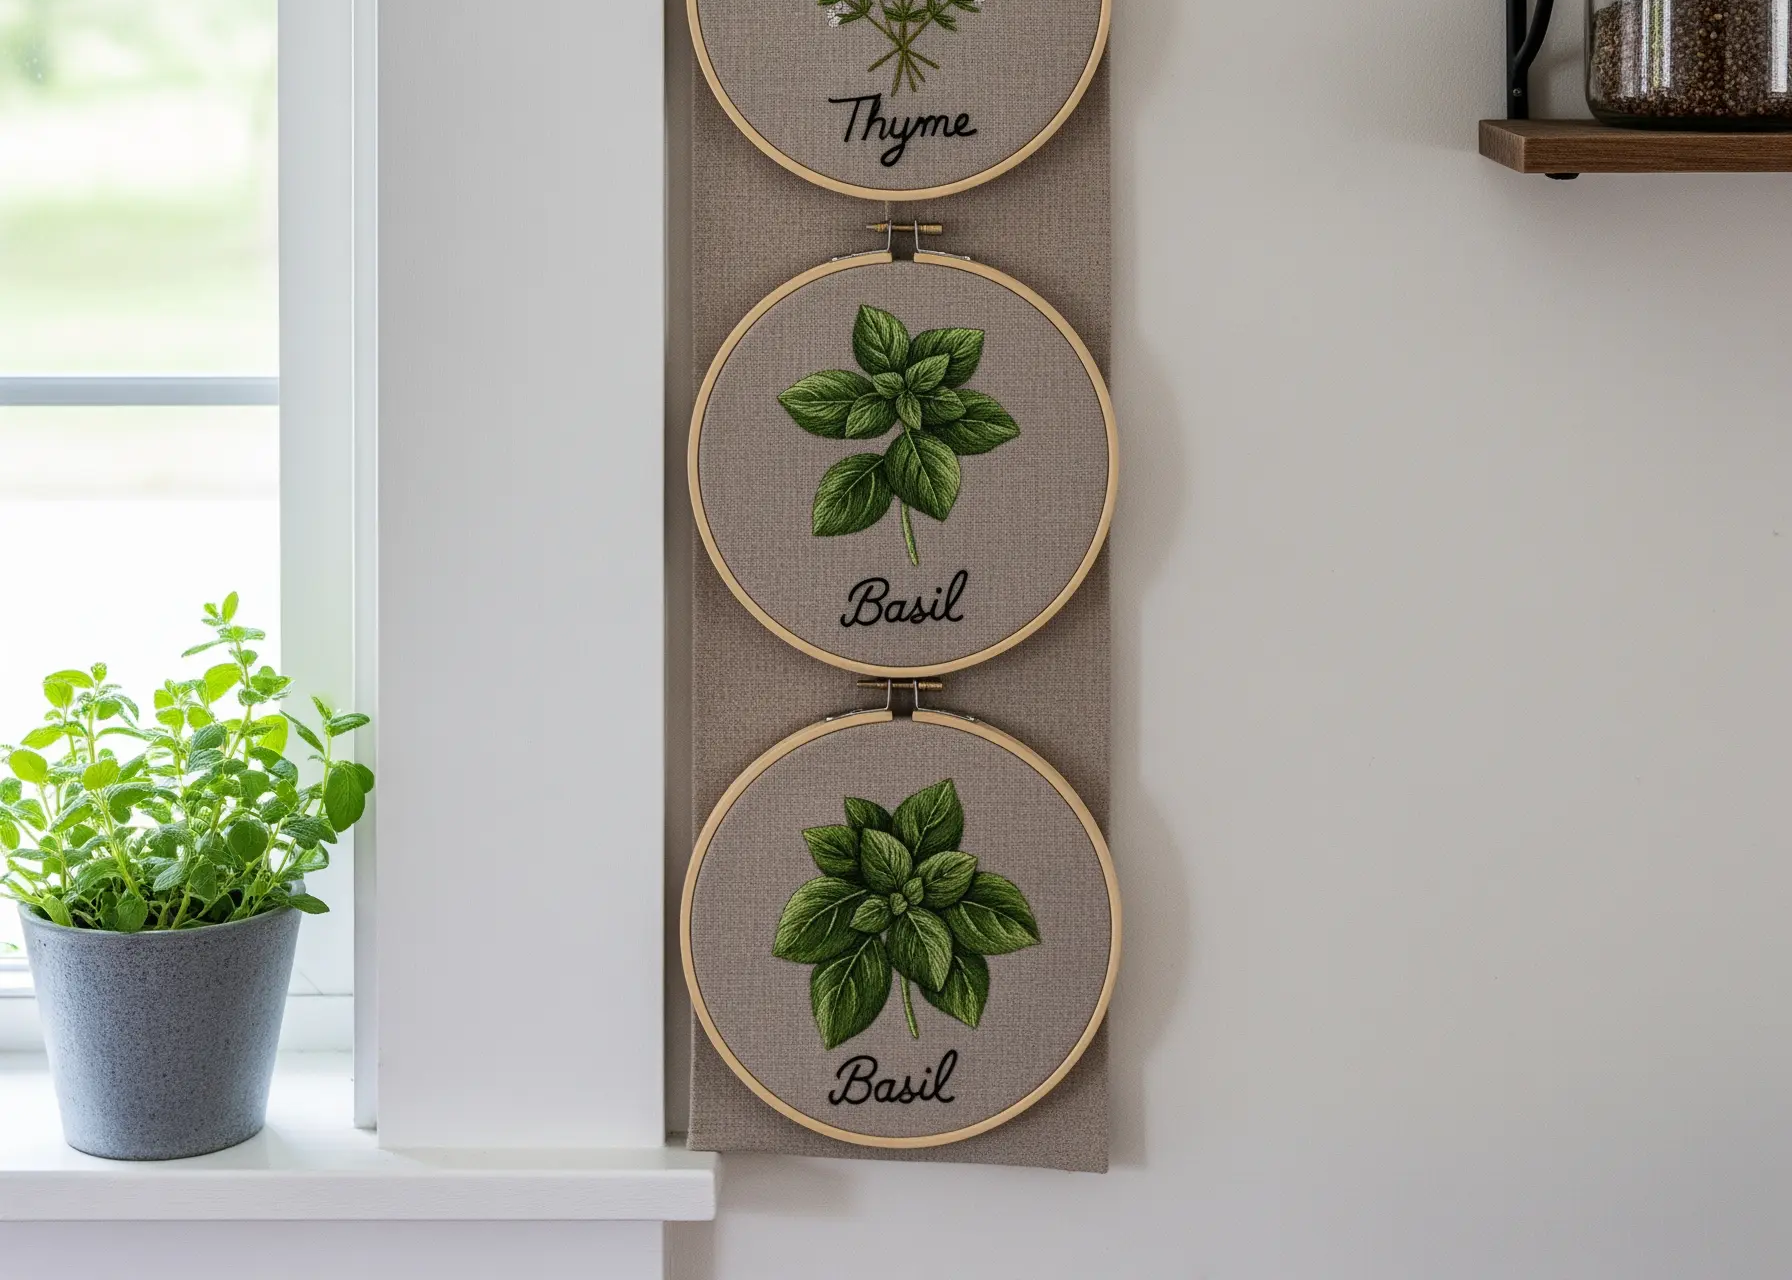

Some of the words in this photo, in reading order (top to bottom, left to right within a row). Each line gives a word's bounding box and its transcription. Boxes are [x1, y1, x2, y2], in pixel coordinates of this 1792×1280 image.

[827, 92, 978, 168] Thyme
[839, 569, 969, 628] Basil
[827, 1048, 959, 1106] Basil
